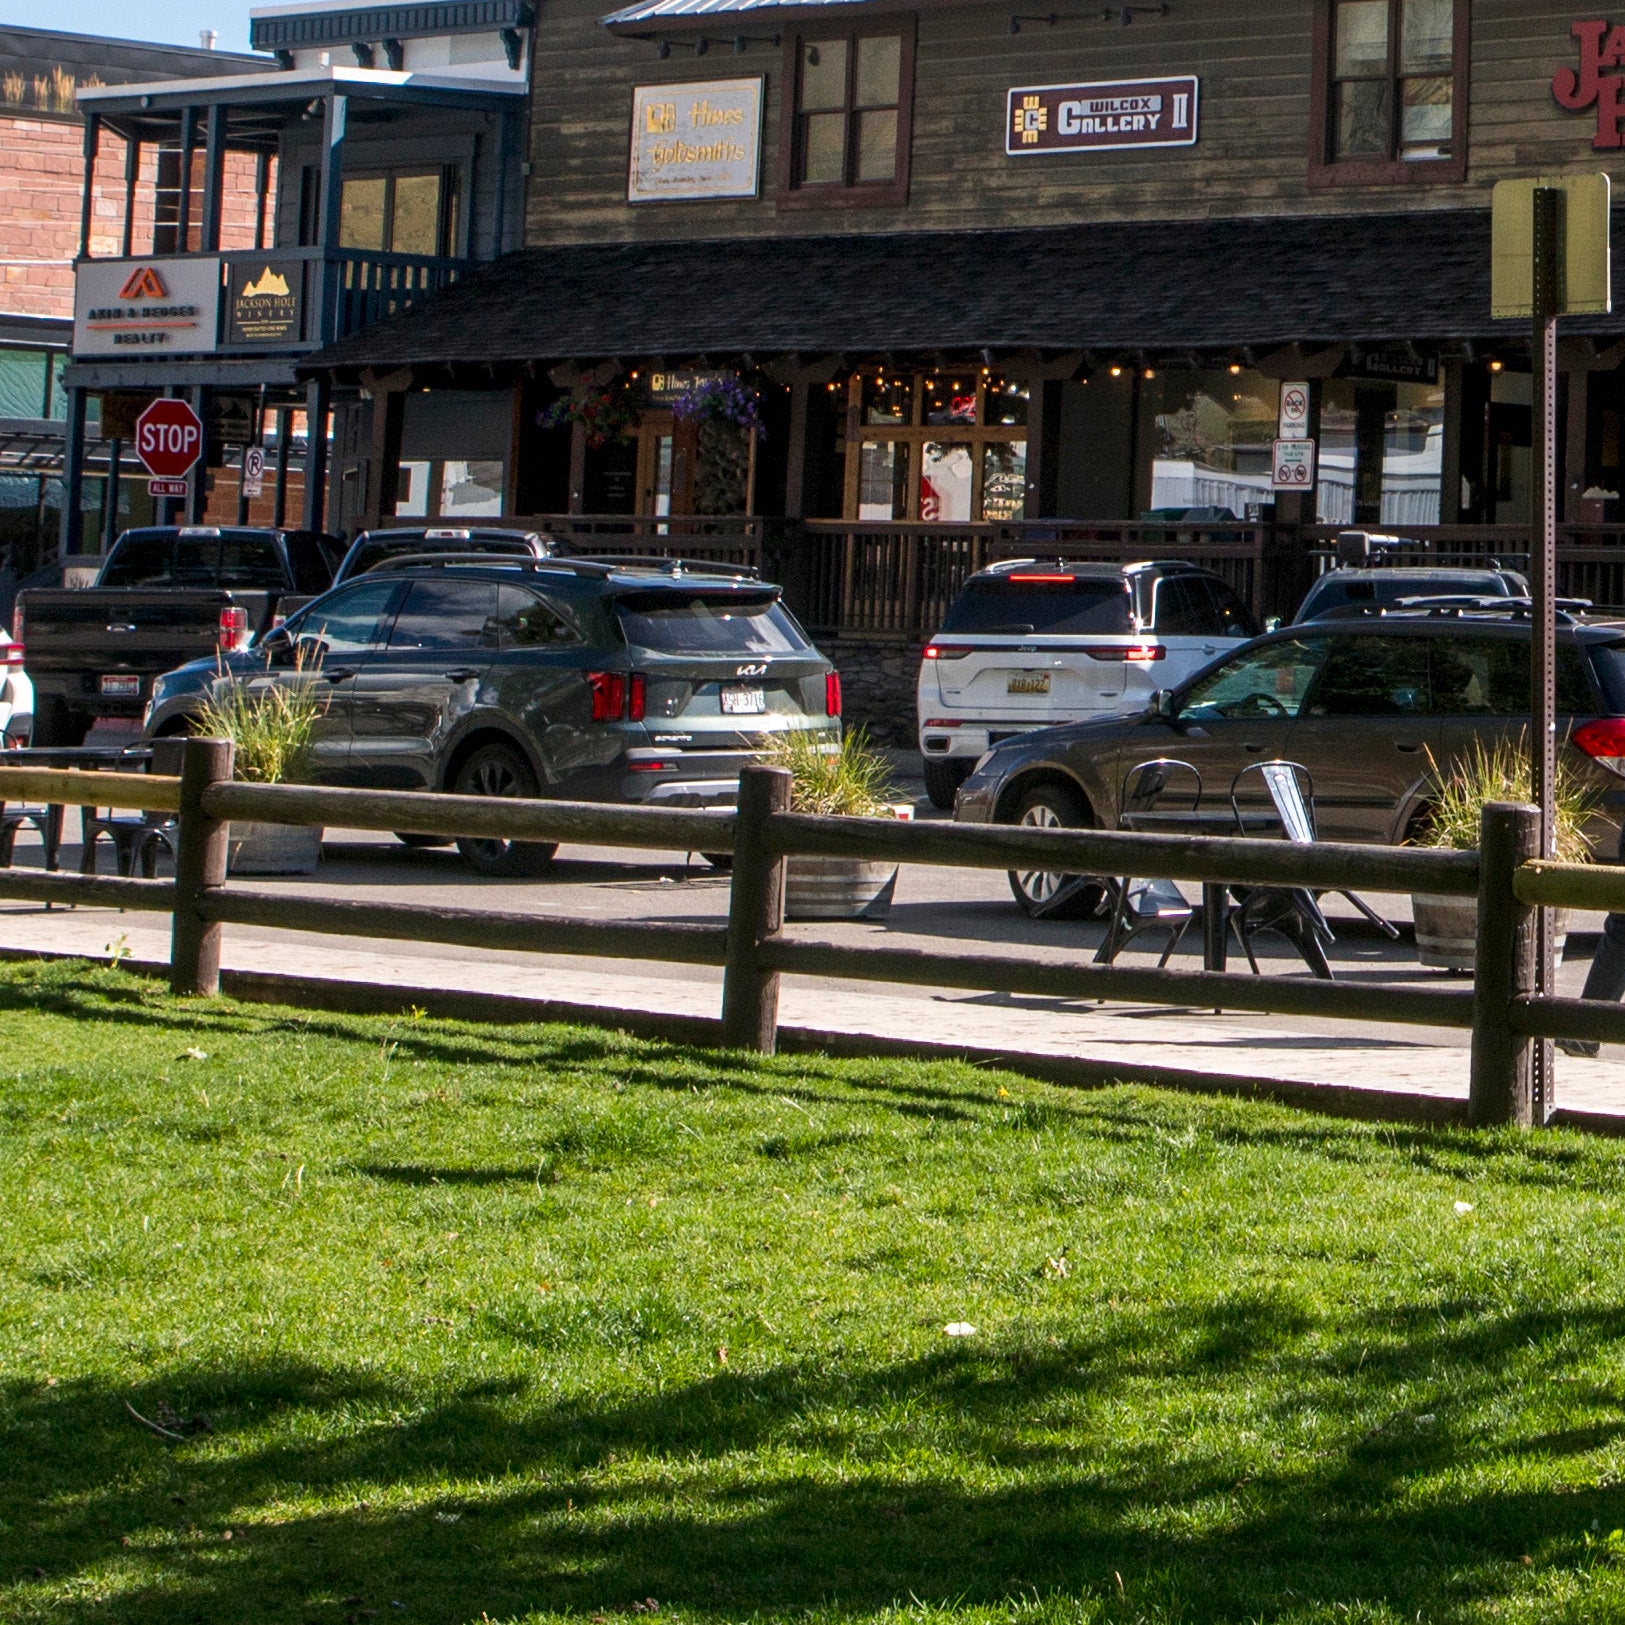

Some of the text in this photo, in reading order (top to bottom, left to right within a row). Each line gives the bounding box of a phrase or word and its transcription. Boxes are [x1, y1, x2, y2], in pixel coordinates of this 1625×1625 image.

[689, 99, 744, 128] Hines
[1057, 100, 1161, 136] GALLERY
[1090, 98, 1151, 113] WILCOX
[647, 137, 745, 167] Goldsmiths
[236, 296, 297, 309] JACKSON HOLE
[141, 423, 198, 453] STOP
[152, 483, 184, 493] ALL WAY
